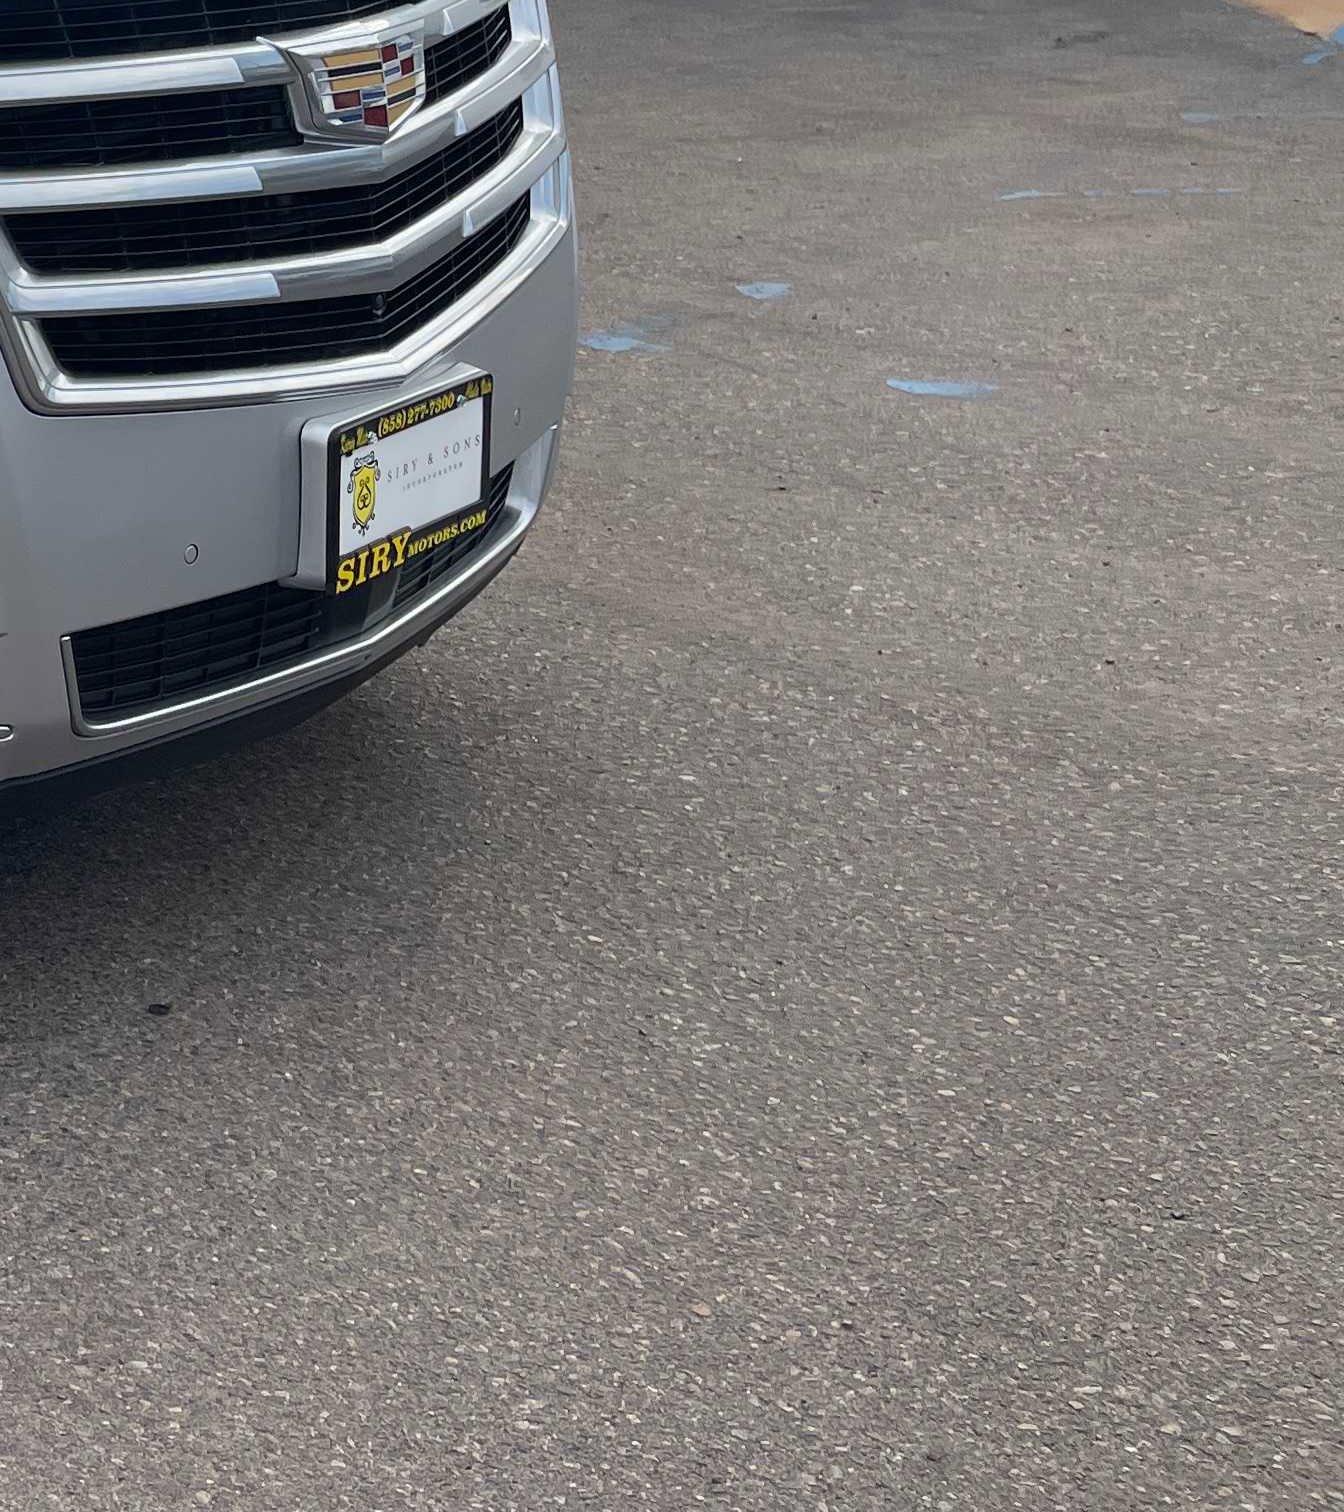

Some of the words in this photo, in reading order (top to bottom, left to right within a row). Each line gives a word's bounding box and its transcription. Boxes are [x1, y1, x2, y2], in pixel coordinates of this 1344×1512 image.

[384, 459, 418, 484] SIRY
[426, 452, 434, 465] &
[443, 434, 481, 458] SONS
[336, 529, 411, 595] SIRY
[408, 510, 487, 557] MOTORS.COM
